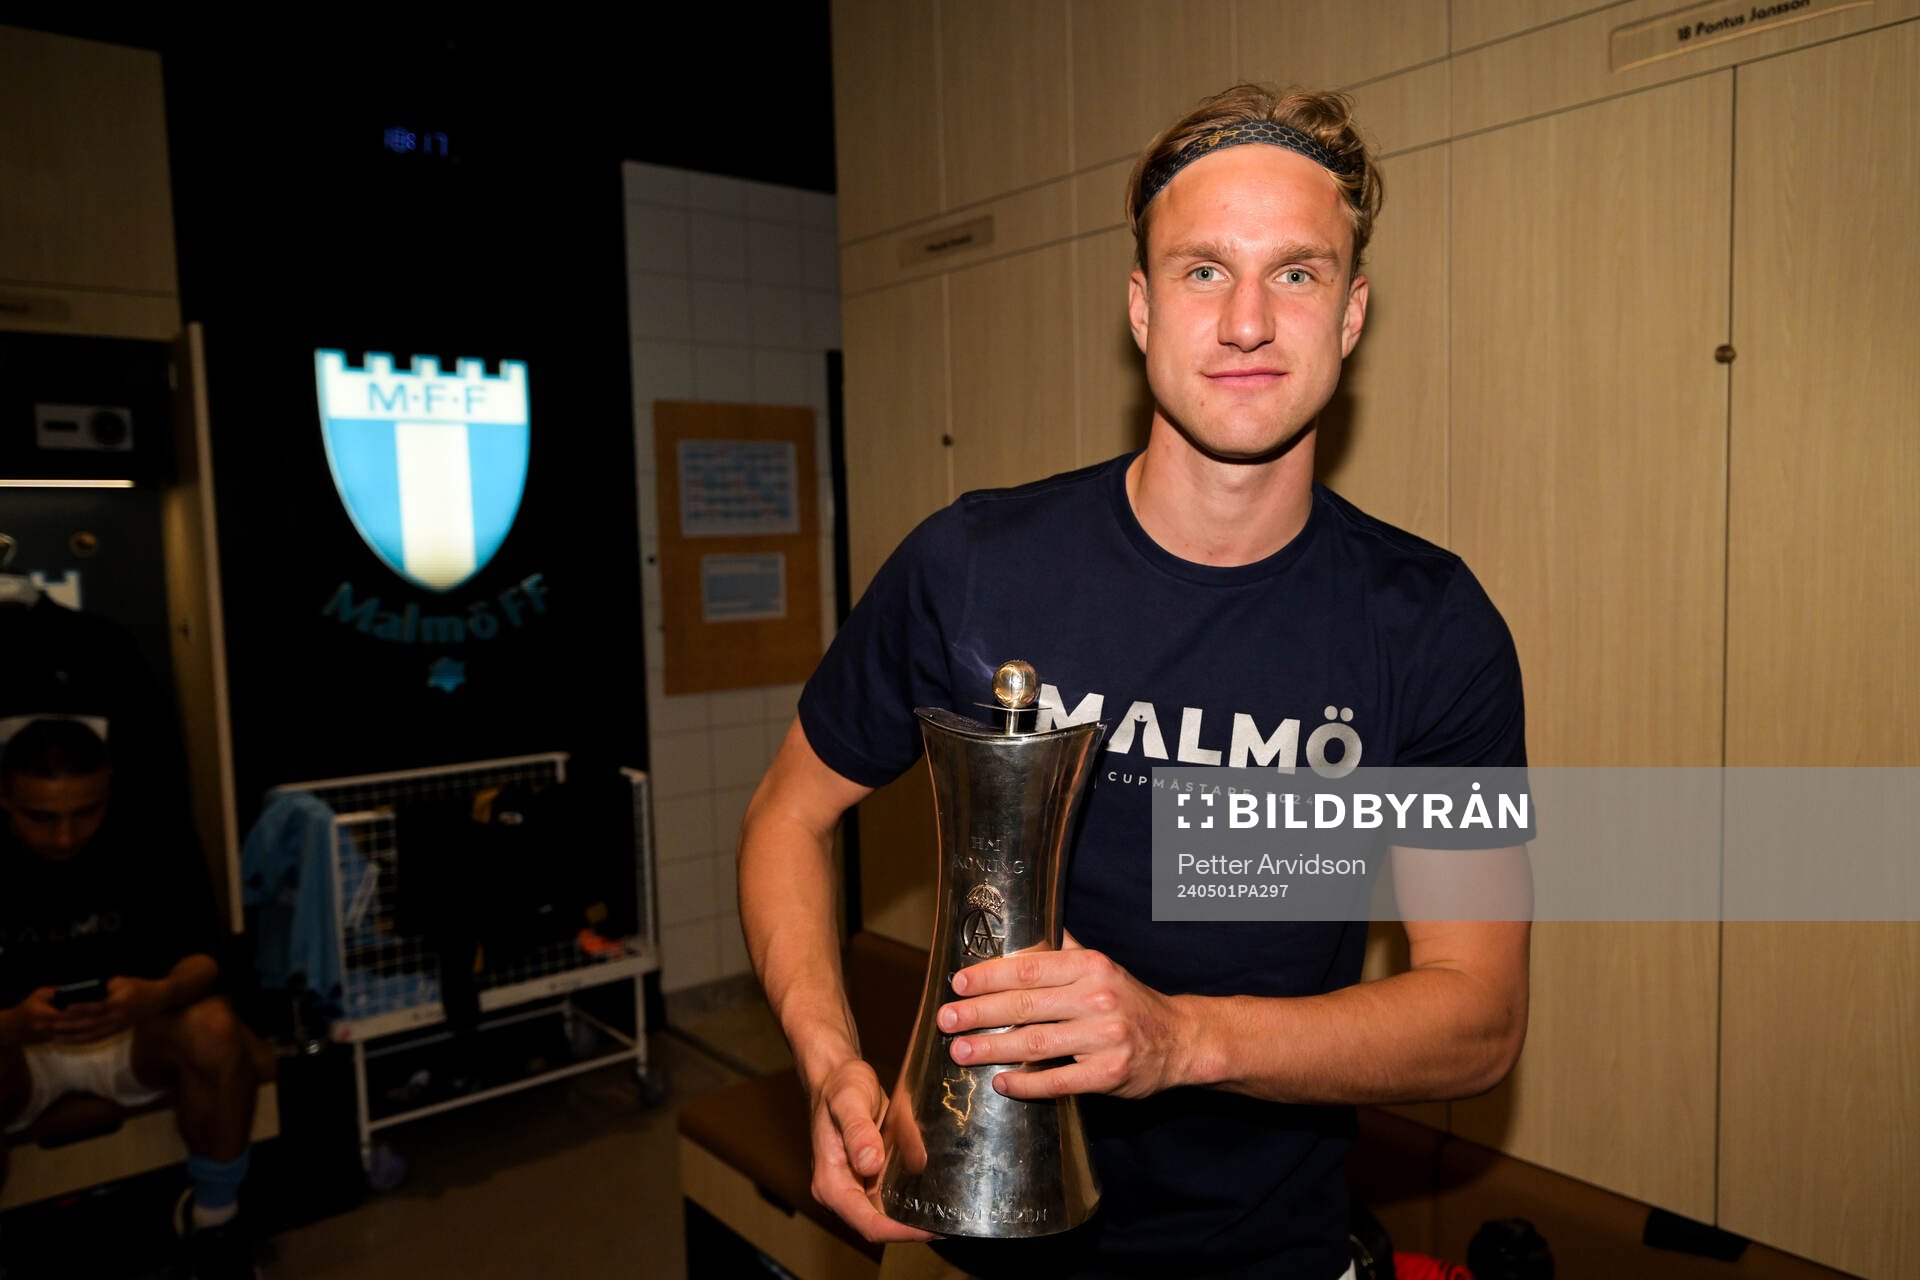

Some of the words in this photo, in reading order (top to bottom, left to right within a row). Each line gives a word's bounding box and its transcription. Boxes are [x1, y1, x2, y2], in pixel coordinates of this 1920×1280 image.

[1694, 14, 1745, 37] Pontus
[320, 579, 500, 646] Malmö
[498, 571, 550, 629] FF
[1037, 683, 1363, 779] MALMÖ
